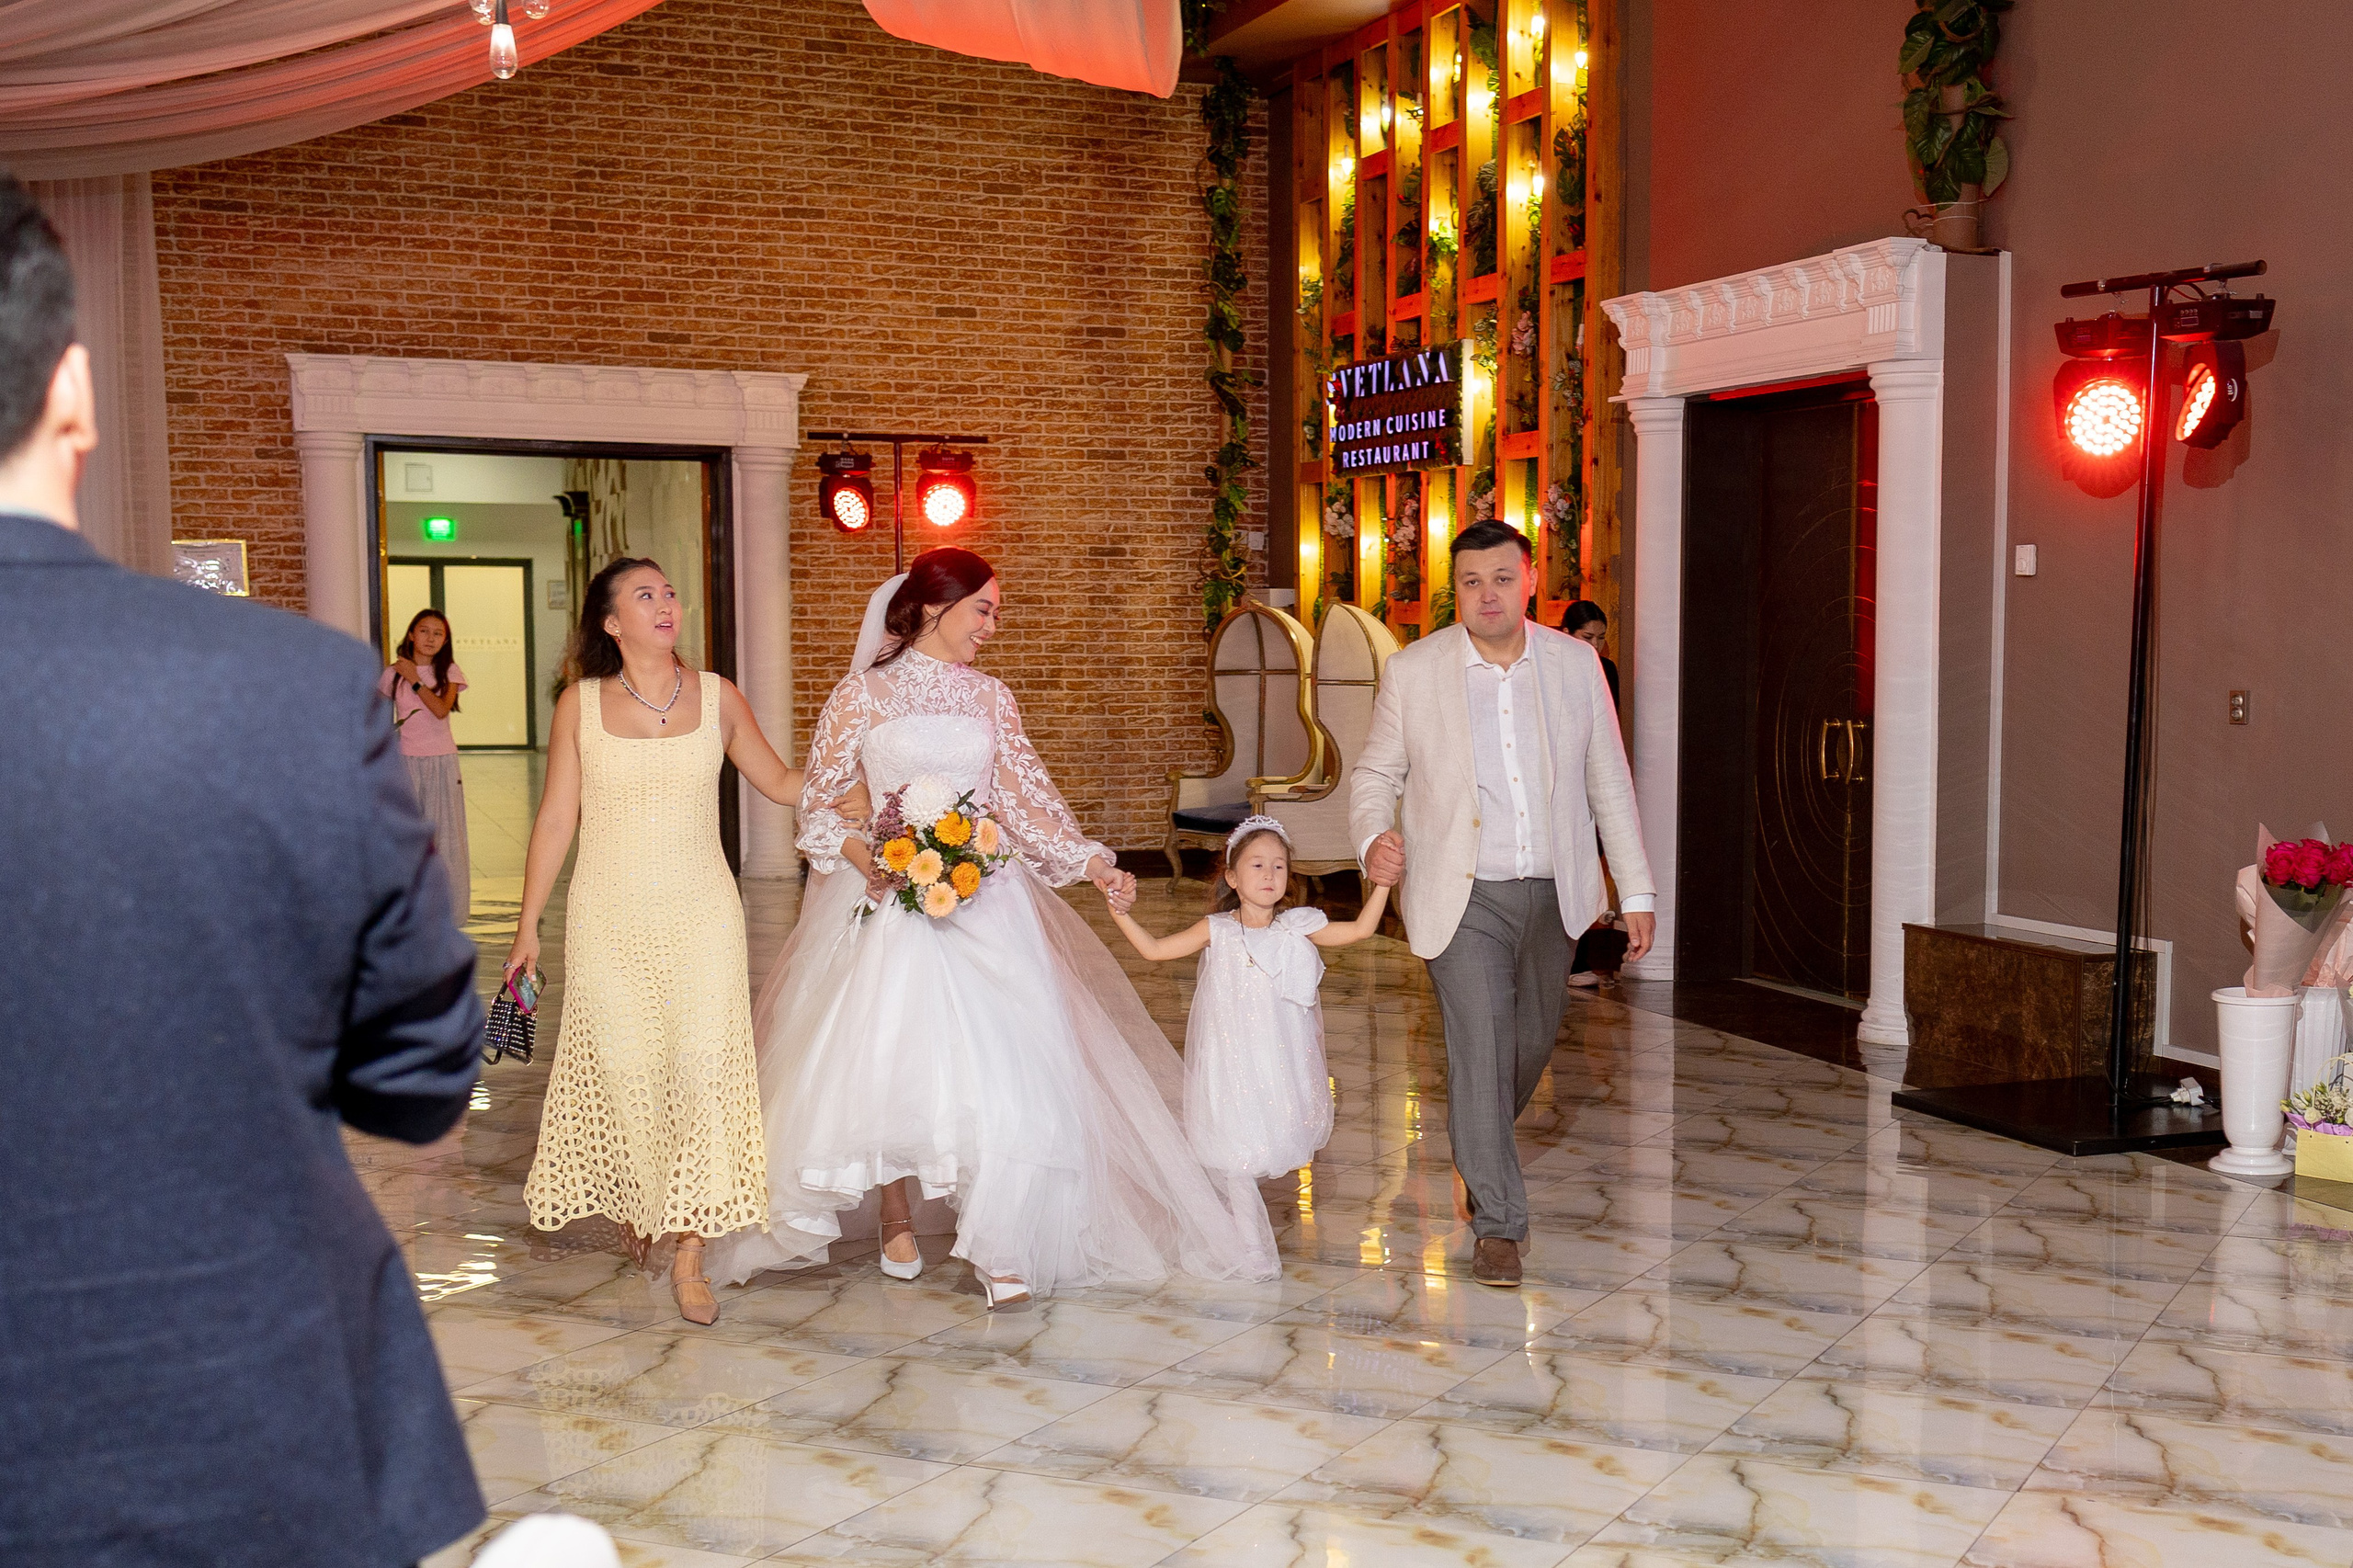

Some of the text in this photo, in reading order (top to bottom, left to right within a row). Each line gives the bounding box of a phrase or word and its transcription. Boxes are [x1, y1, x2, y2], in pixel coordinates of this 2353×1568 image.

[1329, 409, 1446, 443] MODERN CUISINE
[1342, 441, 1429, 468] RESTAURANT
